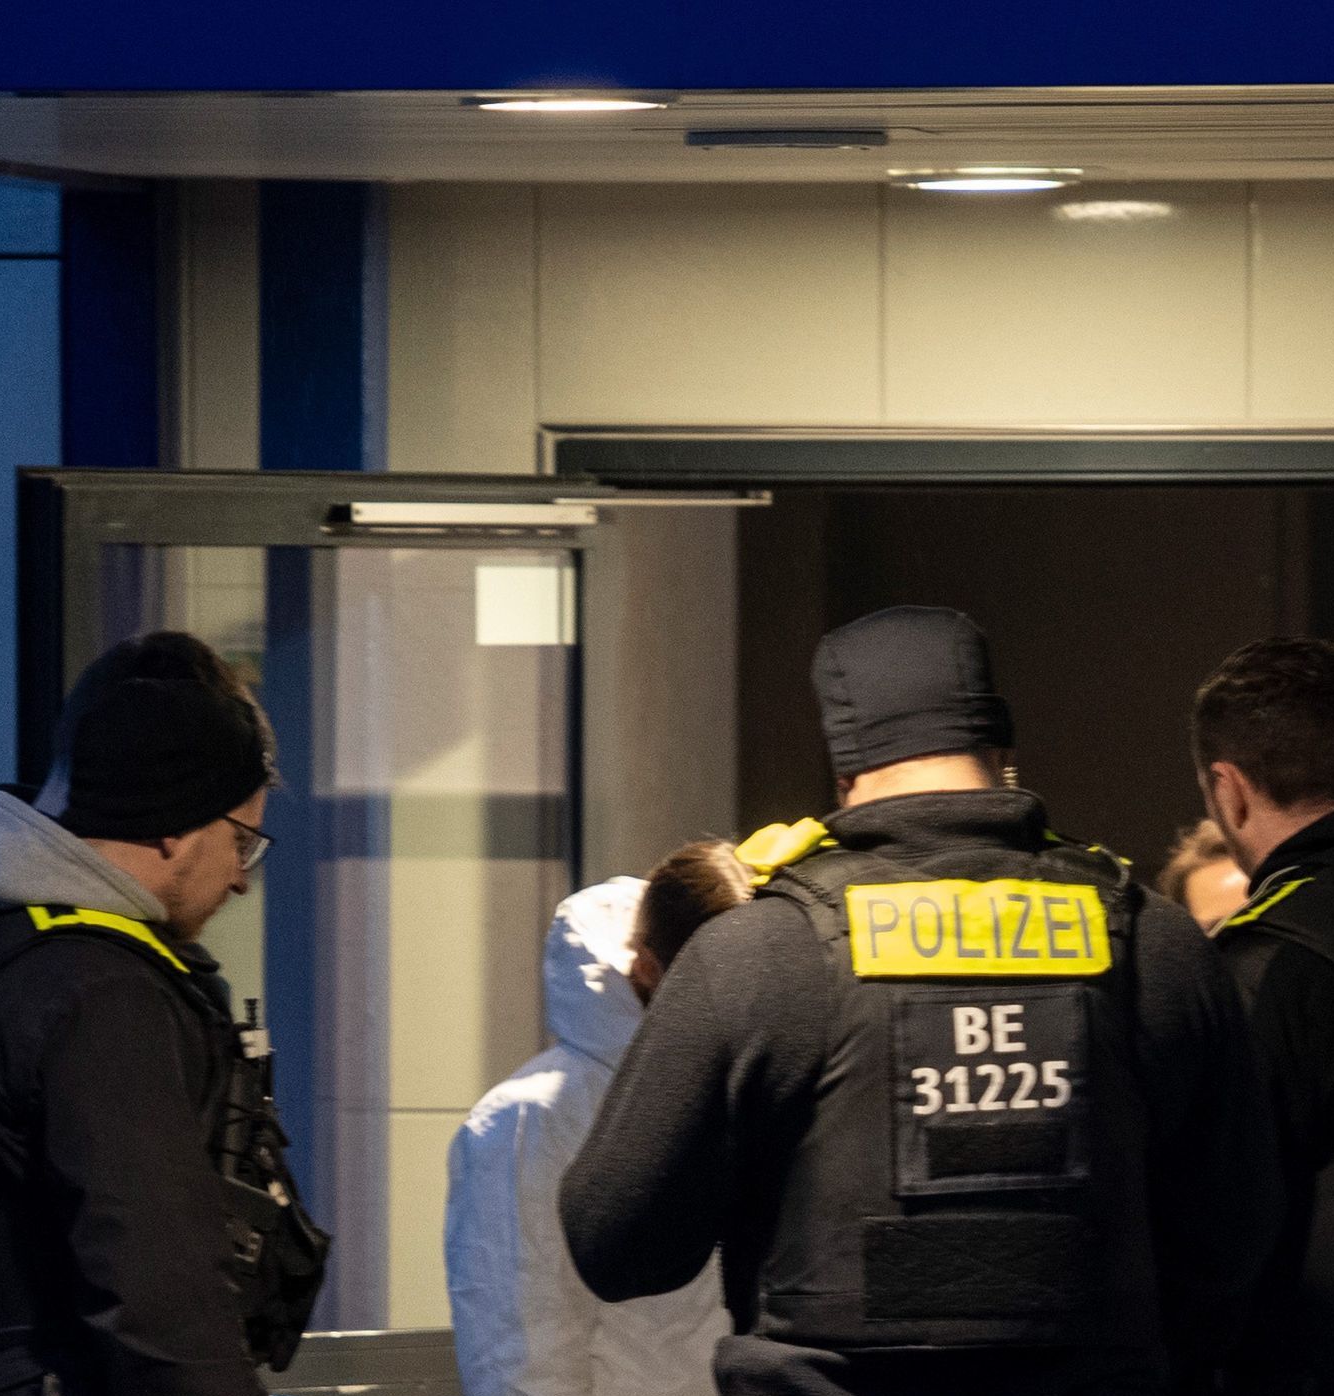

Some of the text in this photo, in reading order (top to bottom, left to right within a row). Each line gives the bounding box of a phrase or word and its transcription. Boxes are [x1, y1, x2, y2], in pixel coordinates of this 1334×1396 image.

[867, 893, 1094, 960] POLIZEI
[952, 1004, 1027, 1055] BE
[910, 1060, 1072, 1116] 31225
